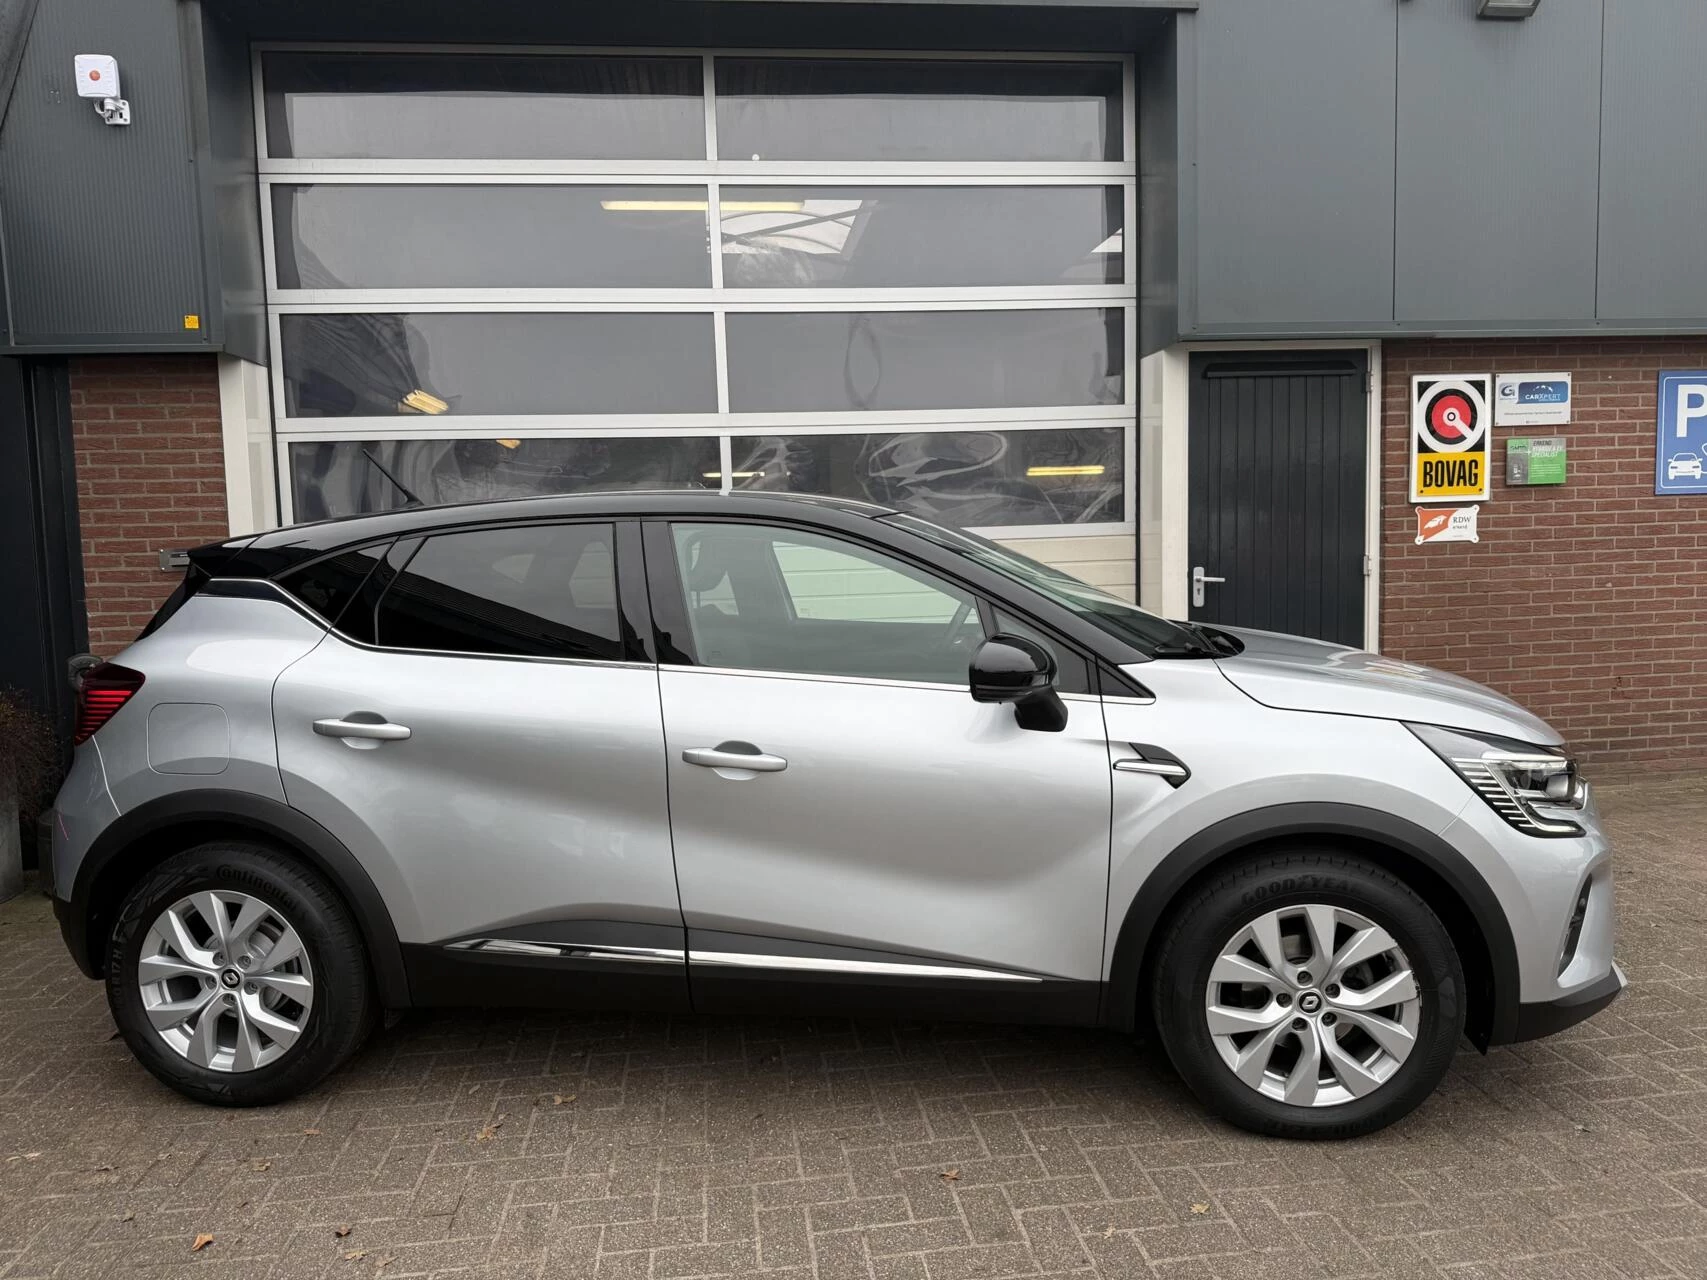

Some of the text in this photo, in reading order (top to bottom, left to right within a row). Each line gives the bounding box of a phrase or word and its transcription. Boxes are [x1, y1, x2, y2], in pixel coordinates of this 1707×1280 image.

[1525, 393, 1561, 401] CARXPERT
[1676, 384, 1707, 438] P
[1423, 459, 1479, 488] BOVAG
[1453, 516, 1472, 524] RDW
[216, 864, 297, 912] Continental
